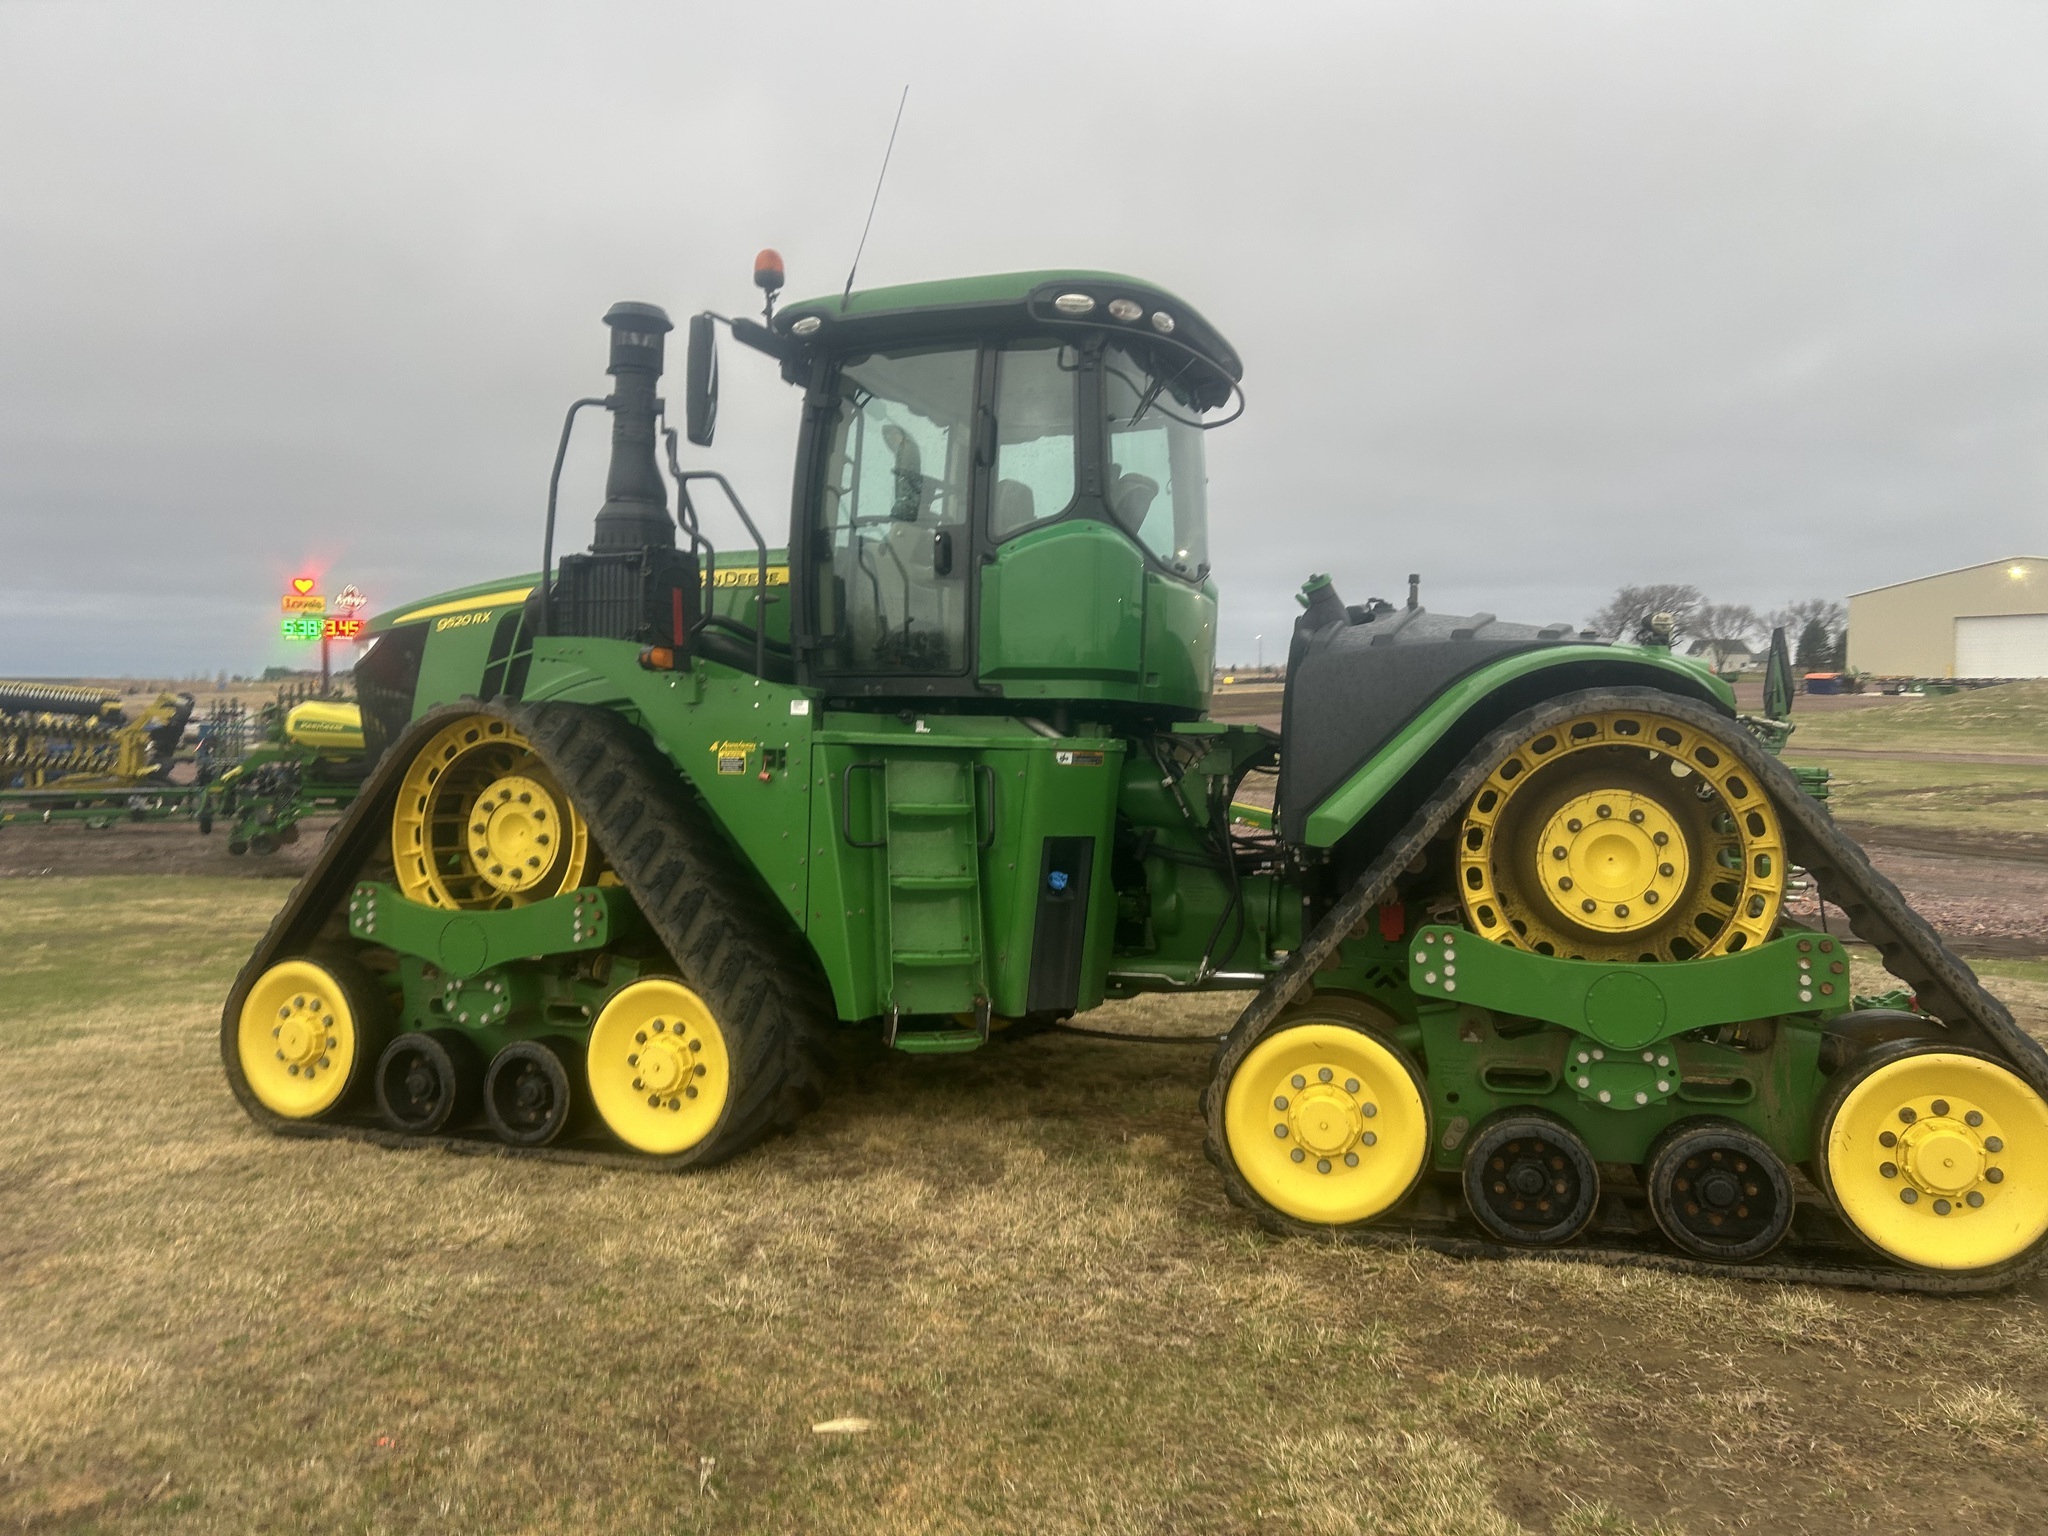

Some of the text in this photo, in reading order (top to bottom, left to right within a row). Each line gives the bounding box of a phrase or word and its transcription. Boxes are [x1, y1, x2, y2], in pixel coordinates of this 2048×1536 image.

[725, 571, 780, 586] DEEE
[436, 610, 493, 632] 9520 RX
